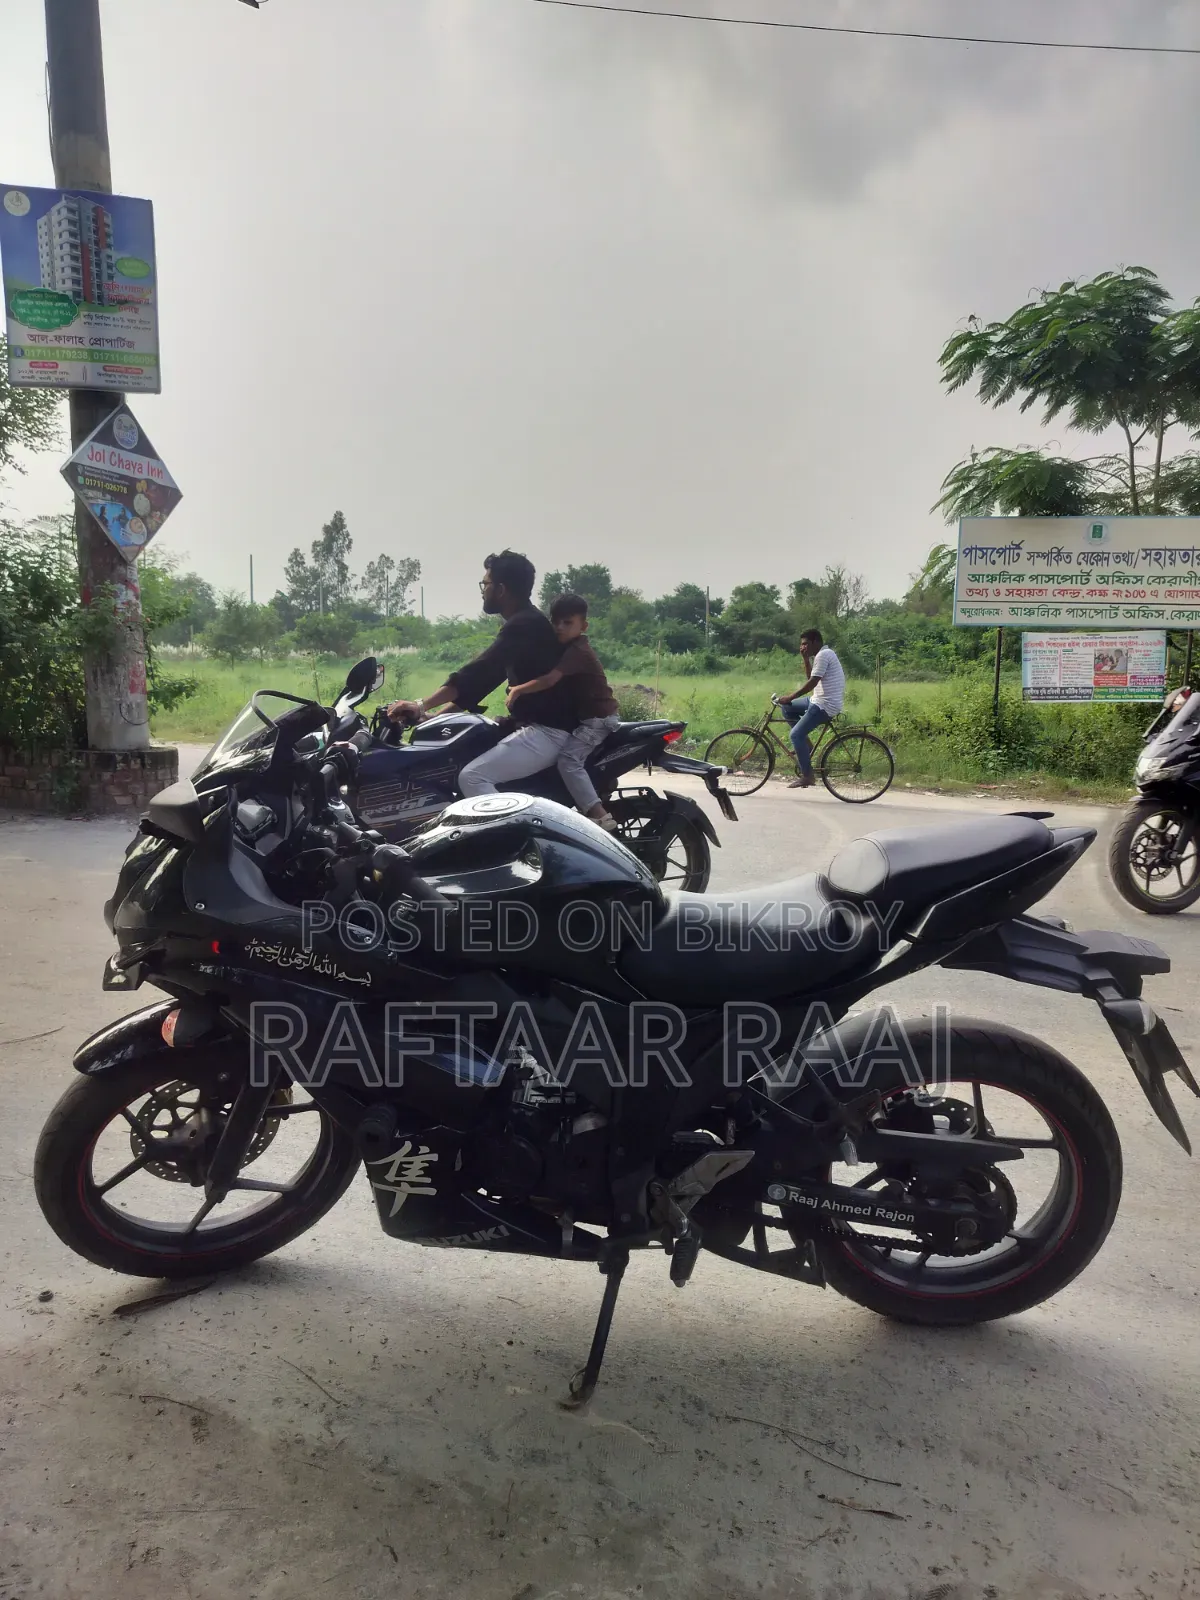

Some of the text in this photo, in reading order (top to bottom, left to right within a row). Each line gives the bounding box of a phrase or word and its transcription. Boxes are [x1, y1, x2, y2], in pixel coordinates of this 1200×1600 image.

[89, 335, 135, 350] প্রোপার্টিজ
[87, 445, 106, 464] Jol
[109, 451, 143, 475] Chaya
[147, 461, 164, 479] Inn
[962, 540, 1025, 566] পাসপোর্ট
[1026, 546, 1073, 567] সম্পর্কিত
[1076, 549, 1111, 567] যেকোন
[967, 570, 1026, 584] আঞ্চলিক
[1028, 569, 1092, 585] পাসপোর্ট
[1096, 571, 1145, 585] অফিস
[965, 588, 989, 598] তথ্য
[993, 588, 1001, 597] ও
[1005, 588, 1048, 598] সহায়তা
[1086, 588, 1109, 598] কক্ষ
[1124, 589, 1146, 598] ১০৩
[1150, 590, 1159, 598] এ
[1009, 604, 1062, 618] আঞ্চলিক
[1065, 605, 1120, 619] পাসপোর্ট
[367, 1140, 439, 1218] 隼
[789, 1191, 819, 1208] Raaj
[821, 1201, 872, 1216] Ahmed
[875, 1208, 915, 1223] Rajon
